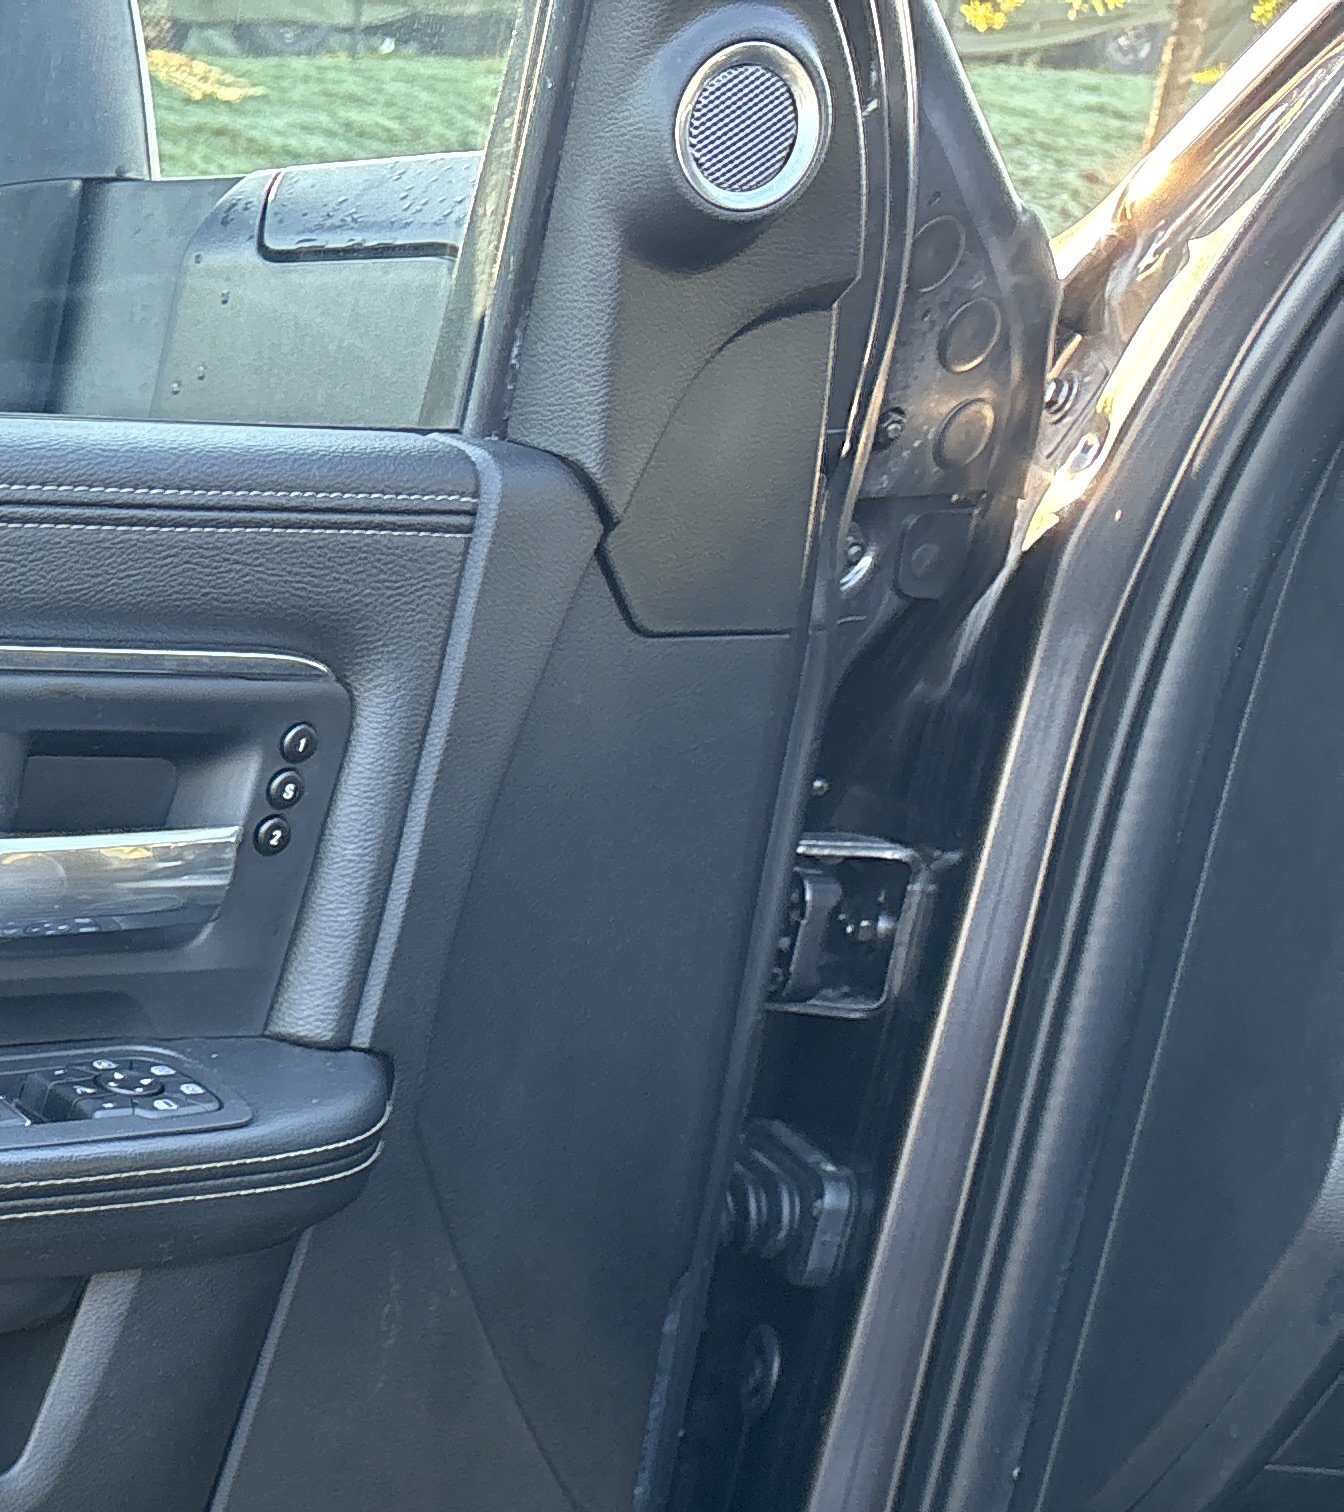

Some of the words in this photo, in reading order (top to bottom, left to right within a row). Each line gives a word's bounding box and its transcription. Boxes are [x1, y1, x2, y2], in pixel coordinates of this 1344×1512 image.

[298, 738, 307, 753] 1
[282, 783, 296, 800] S
[269, 830, 282, 846] 2
